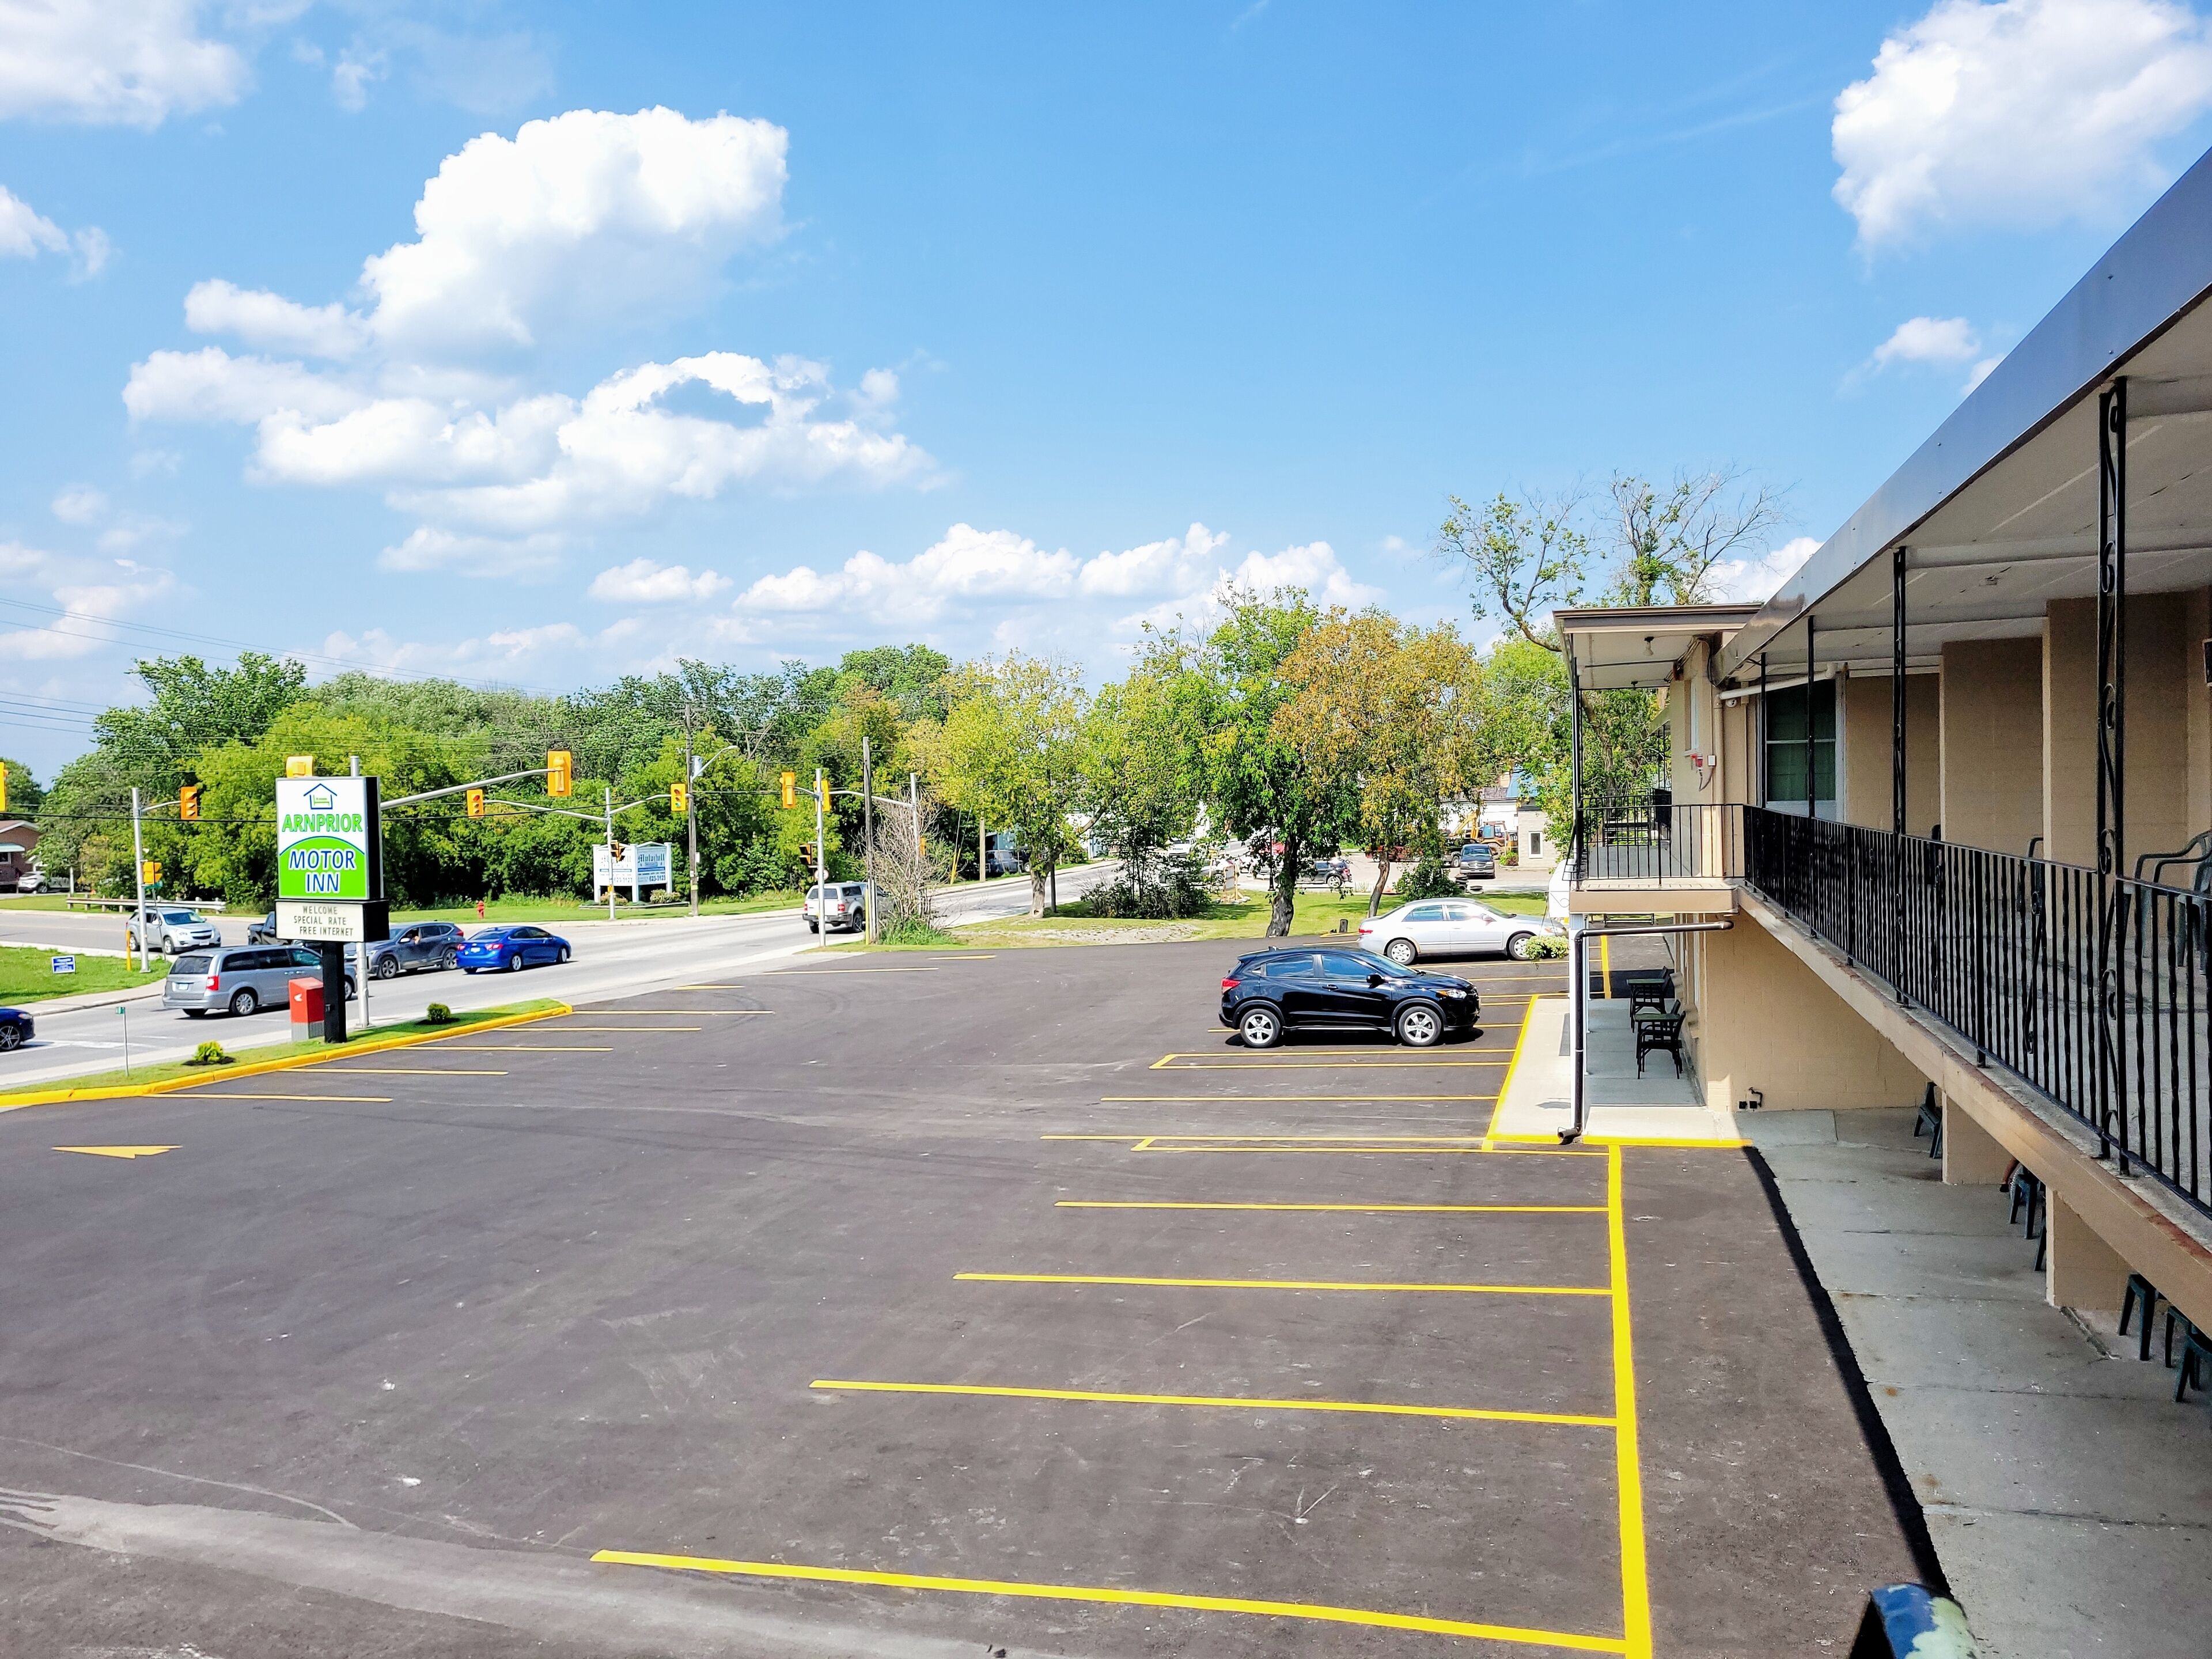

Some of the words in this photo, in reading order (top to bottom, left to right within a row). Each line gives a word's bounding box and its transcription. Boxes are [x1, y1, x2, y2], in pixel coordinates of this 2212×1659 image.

[282, 813, 363, 832] ARNPRIOR
[290, 850, 355, 869] MOTOR
[307, 873, 339, 892] INN
[302, 906, 338, 915] WELCOME
[294, 915, 323, 925] SPECIAL
[328, 917, 347, 925] RATE
[300, 926, 317, 935] FREE
[320, 927, 354, 936] INTERNET
